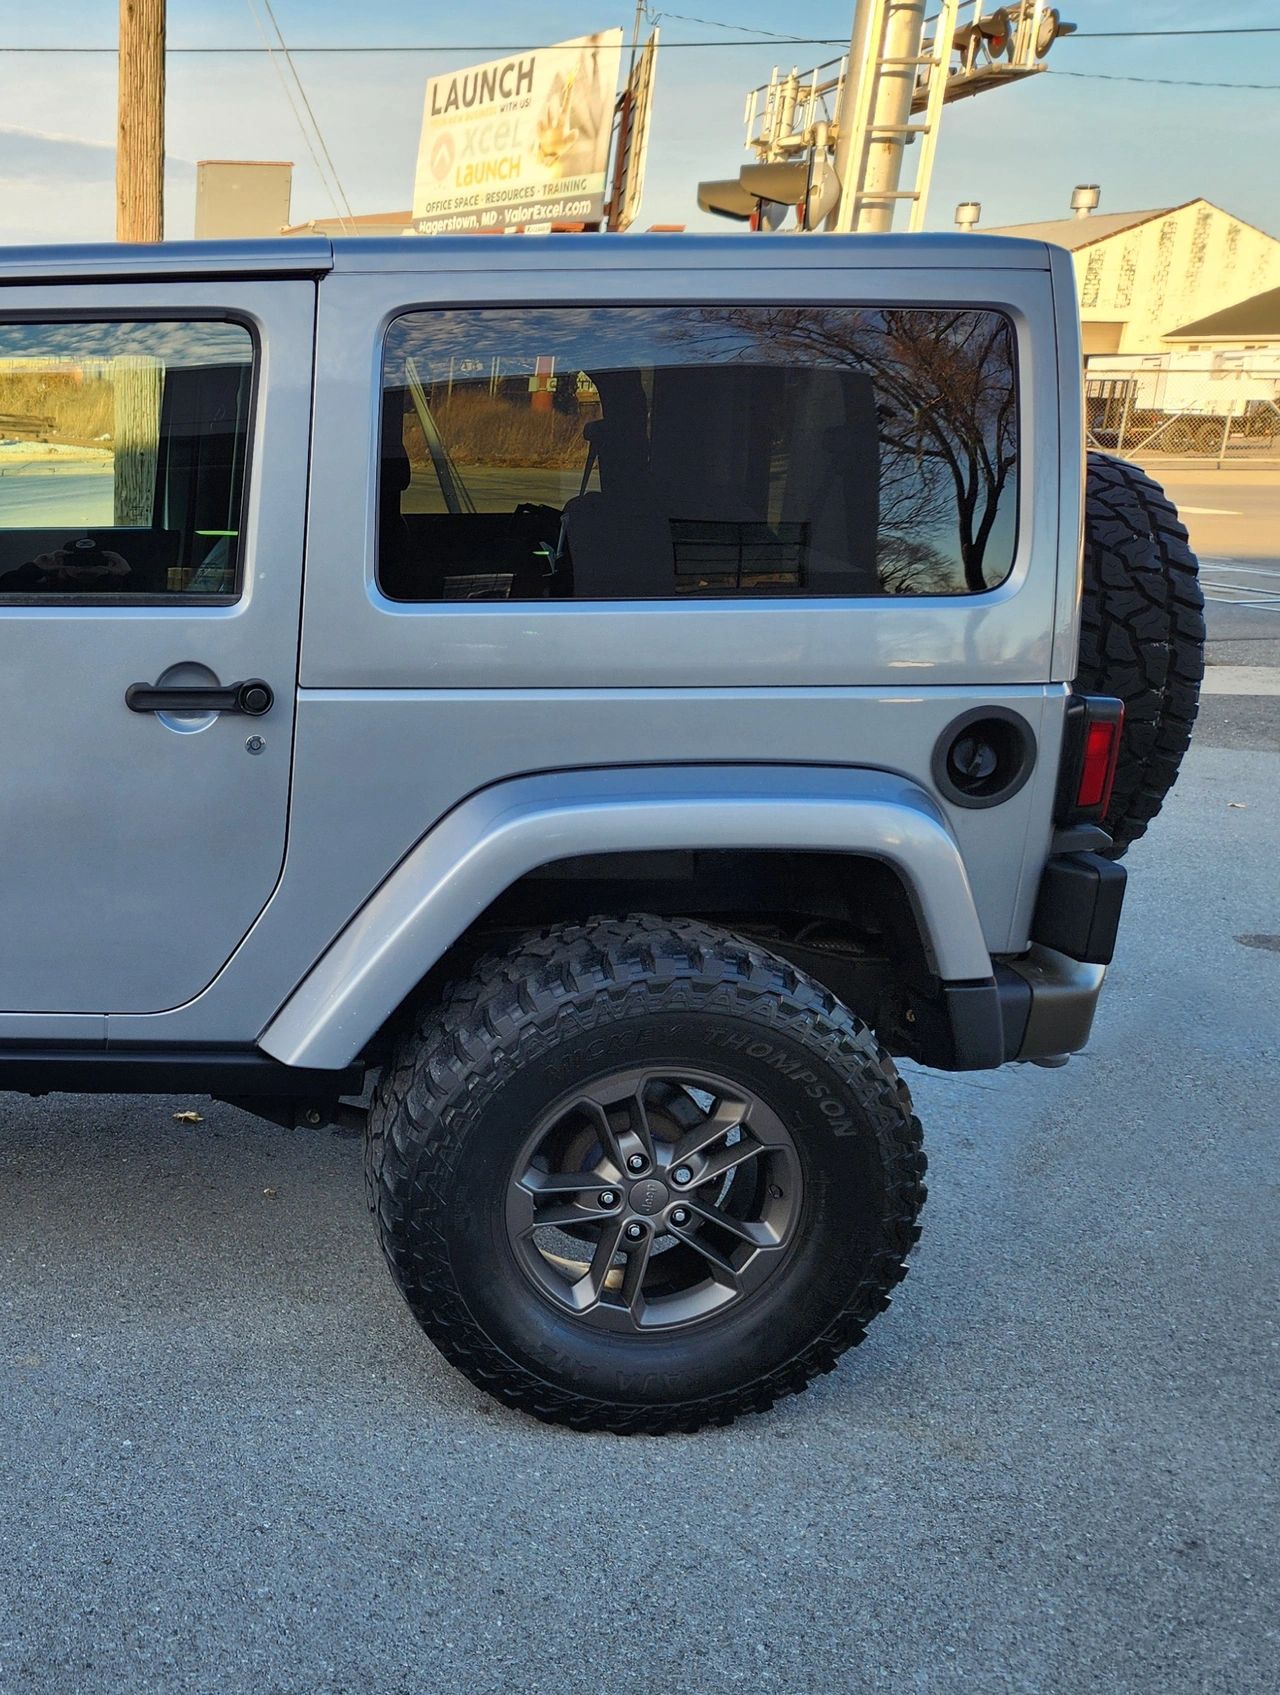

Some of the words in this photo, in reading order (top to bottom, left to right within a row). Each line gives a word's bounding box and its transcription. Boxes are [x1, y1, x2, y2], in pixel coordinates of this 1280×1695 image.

[431, 56, 536, 116] LAUNCH
[500, 102, 519, 113] WITH
[426, 199, 453, 213] OFFICE
[454, 194, 480, 209] SPACE
[485, 185, 535, 204] RESOURCES
[542, 178, 588, 196] TRAINING
[420, 215, 480, 235] Hagerstown,
[481, 210, 498, 225] MD
[504, 199, 592, 224] ValorExcel.com
[704, 1027, 857, 1139] THOMPSON
